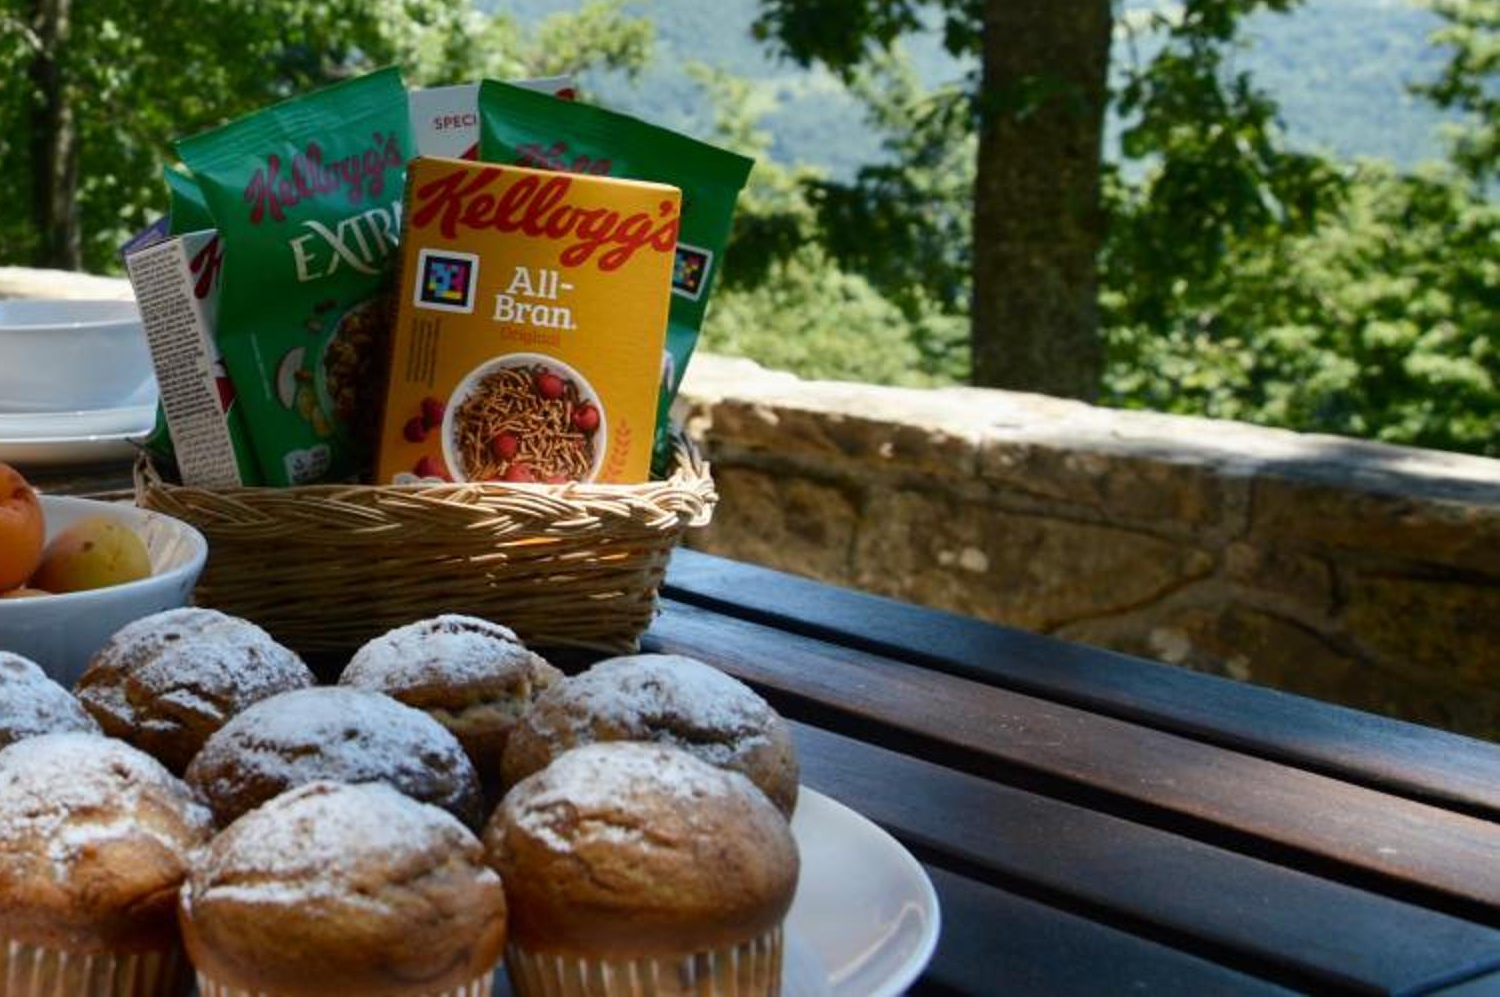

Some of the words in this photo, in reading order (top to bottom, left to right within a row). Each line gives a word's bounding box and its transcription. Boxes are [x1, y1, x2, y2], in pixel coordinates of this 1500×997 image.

[244, 131, 403, 224] Kellogg's
[412, 167, 680, 272] Kellogg's
[506, 266, 575, 300] All-
